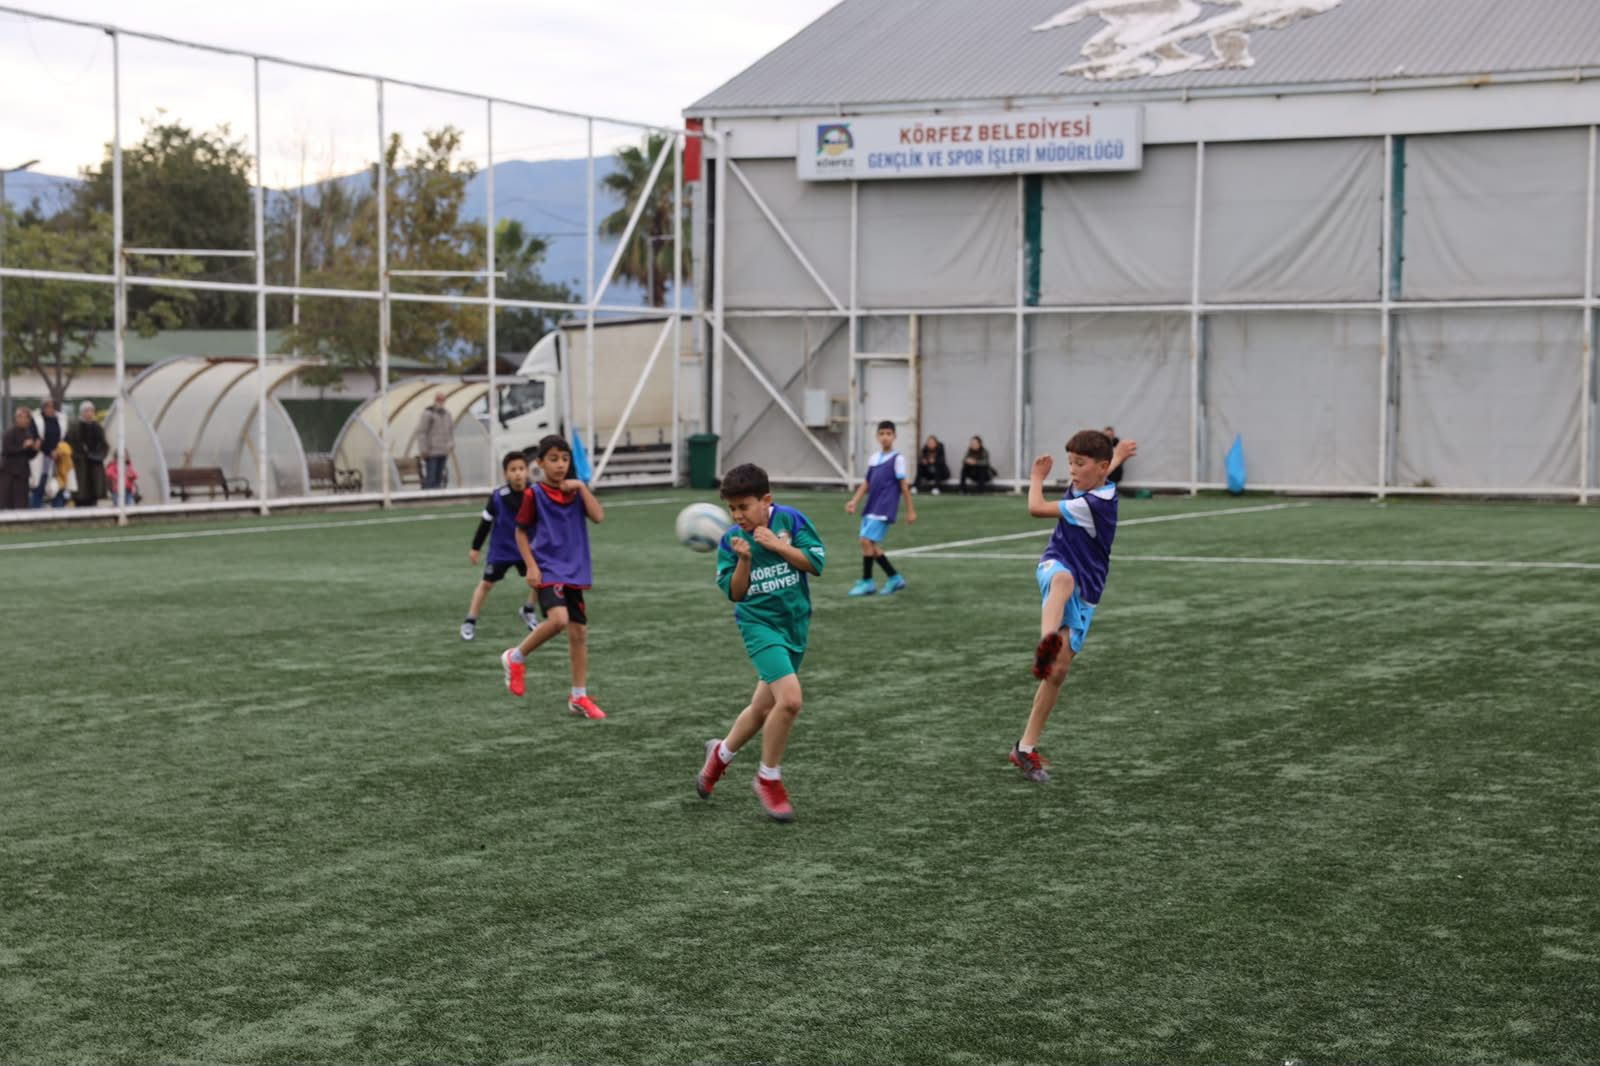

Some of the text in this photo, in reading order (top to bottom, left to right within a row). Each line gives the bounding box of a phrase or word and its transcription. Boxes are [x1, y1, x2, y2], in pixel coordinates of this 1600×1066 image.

[900, 115, 1091, 144] KÖRFEZ BELEDİYESİ
[868, 138, 1124, 171] GENÇLİK VE SPOR İŞLERİ MÜDÜRLÜĞÜ
